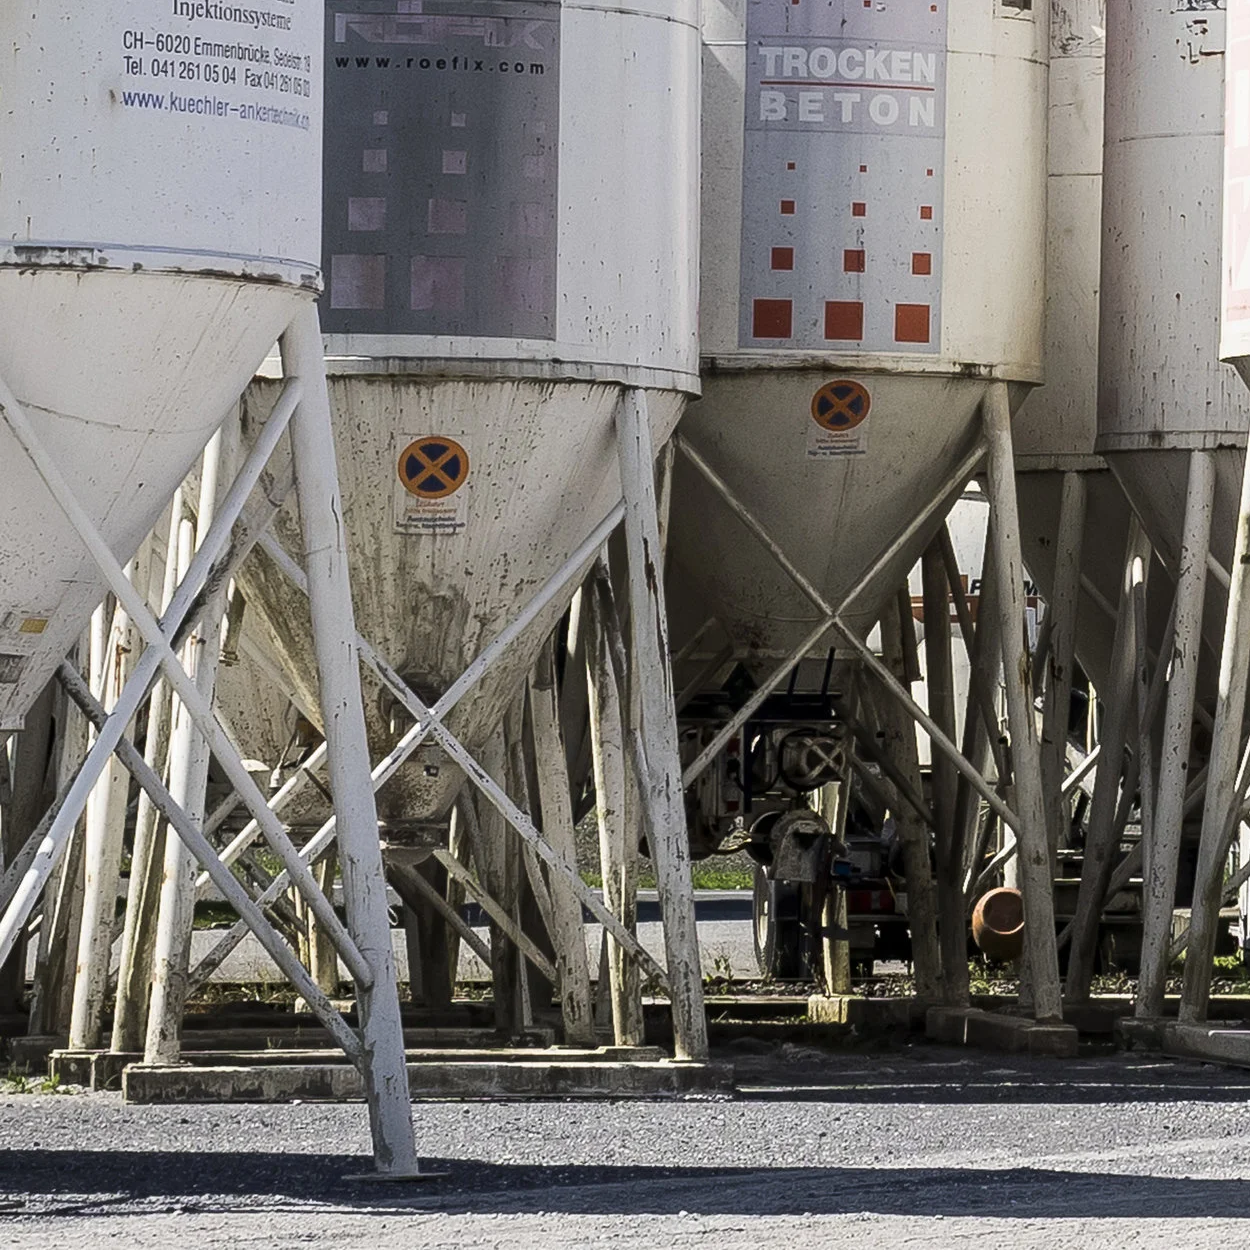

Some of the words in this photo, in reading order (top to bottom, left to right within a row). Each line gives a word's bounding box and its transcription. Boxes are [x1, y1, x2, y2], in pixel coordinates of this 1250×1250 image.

[123, 30, 191, 55] CH-6020
[123, 55, 147, 76] Tel.
[151, 58, 175, 78] 041
[178, 61, 200, 81] 261
[204, 63, 219, 83] 05
[222, 66, 237, 84] 04
[244, 68, 262, 88] Fax
[263, 71, 278, 90] 041
[279, 74, 292, 93] 261
[335, 56, 545, 75] www.roefix.com
[759, 46, 936, 83] TROCKEN
[759, 90, 935, 127] BETON
